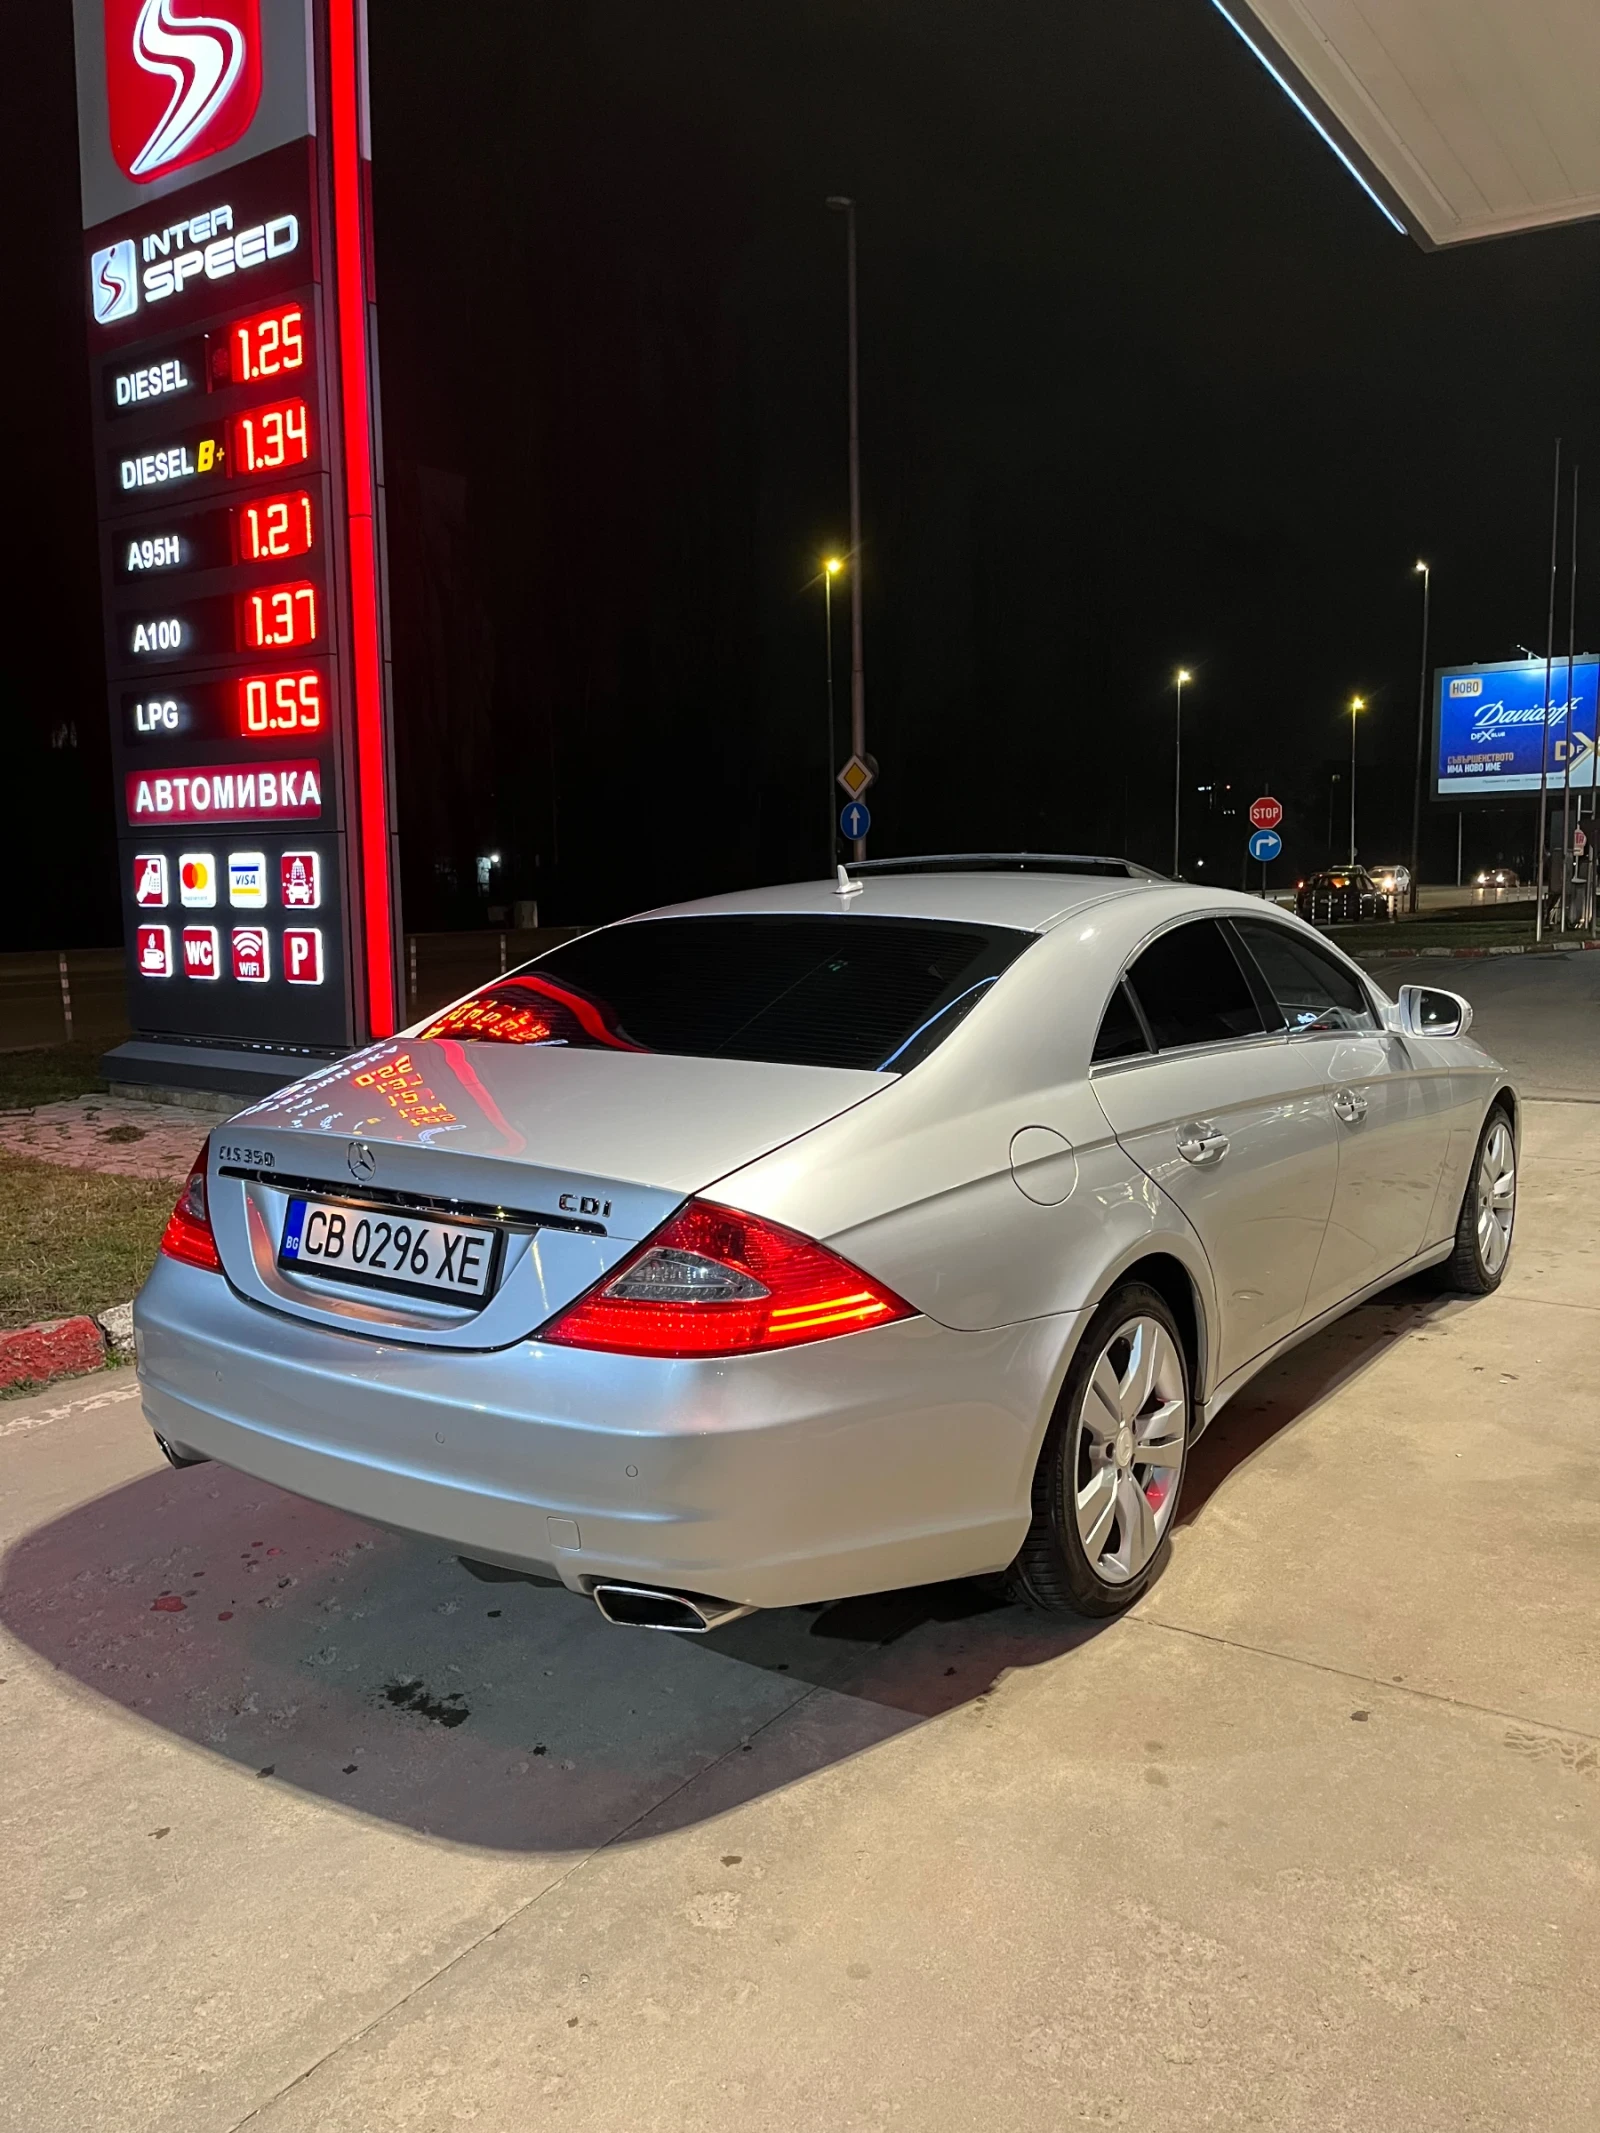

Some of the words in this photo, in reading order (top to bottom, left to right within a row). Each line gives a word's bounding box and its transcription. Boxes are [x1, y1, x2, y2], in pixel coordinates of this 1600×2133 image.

[142, 204, 234, 262] INTER
[143, 214, 299, 302] SPEED
[116, 360, 188, 406] DIESEL
[238, 312, 303, 381] 1.25
[121, 447, 195, 490] DIESEL
[197, 439, 225, 473] B+
[242, 405, 308, 471] 1.34
[127, 535, 180, 571] A95H
[247, 497, 312, 558] 1.21
[133, 619, 181, 653] A100
[252, 588, 316, 646] 1.37
[136, 700, 179, 732] LPG
[246, 675, 320, 731] 0.55
[1452, 681, 1479, 694] НОВО
[135, 770, 322, 813] АВТОМИВКА
[1465, 763, 1484, 773] НОВО
[1485, 762, 1501, 771] ИМЕ
[1253, 807, 1279, 819] STOP
[235, 874, 256, 886] VISA
[185, 940, 212, 966] WC
[291, 937, 309, 976] P
[559, 1193, 611, 1218] CDI
[285, 1235, 299, 1250] BG
[305, 1210, 346, 1259] CB
[352, 1218, 429, 1274] 0296
[435, 1232, 484, 1286] XE
